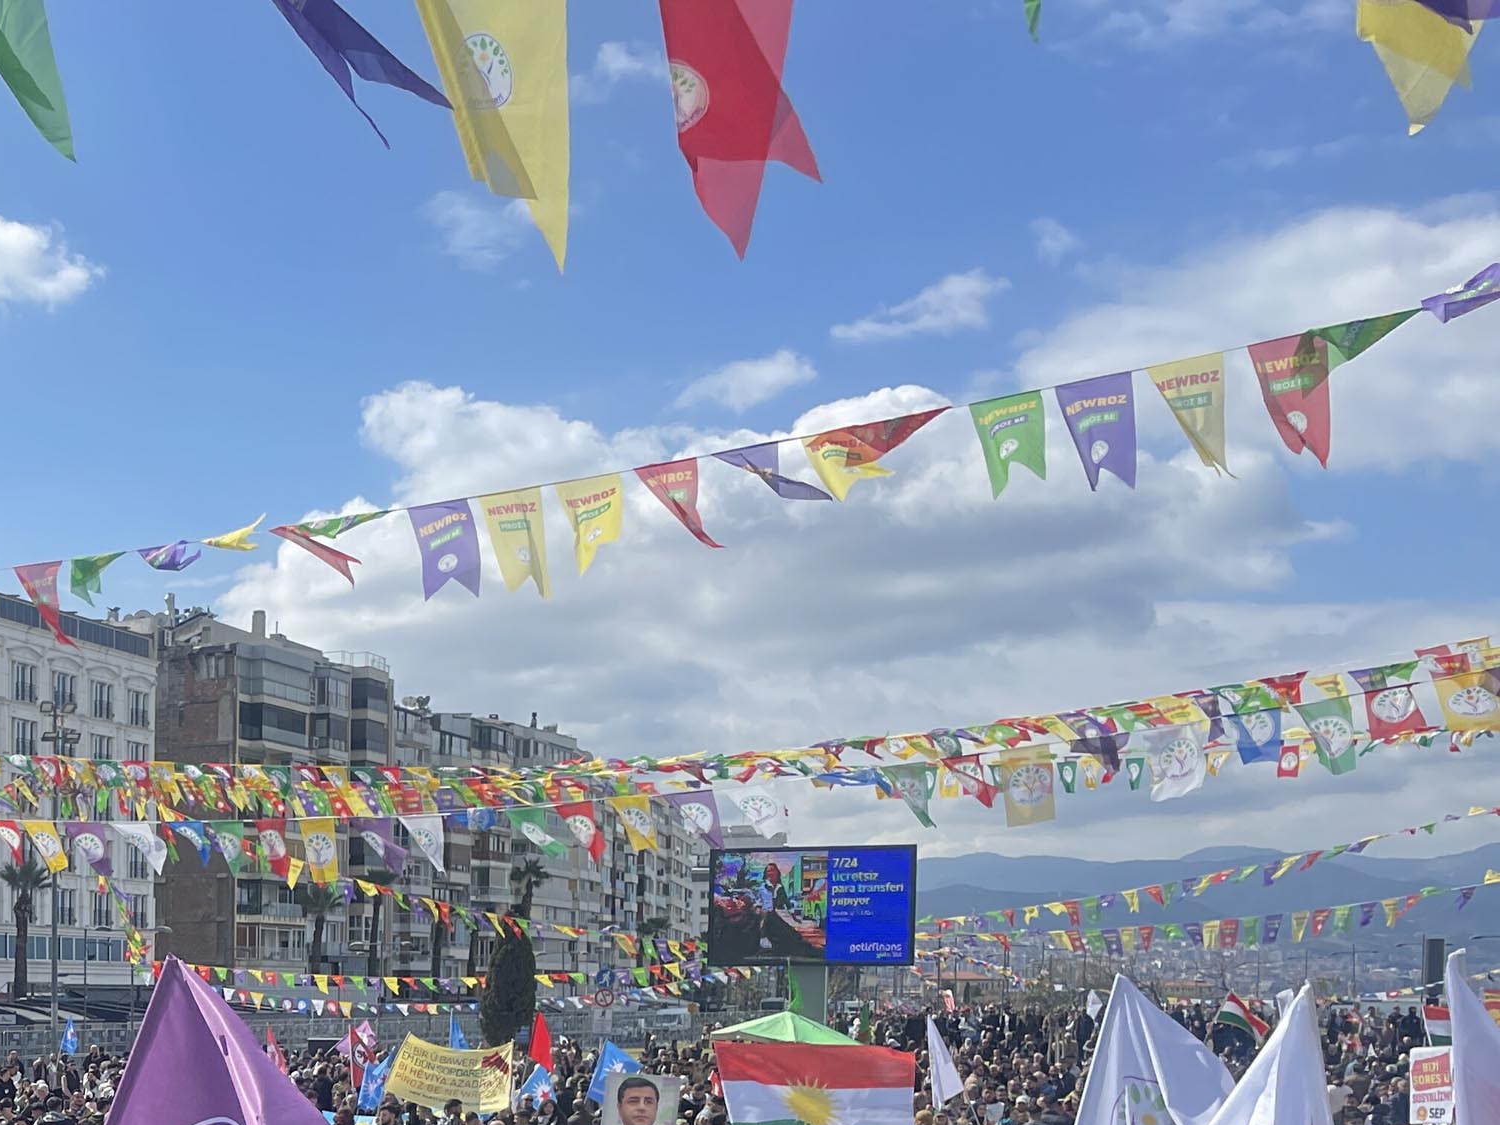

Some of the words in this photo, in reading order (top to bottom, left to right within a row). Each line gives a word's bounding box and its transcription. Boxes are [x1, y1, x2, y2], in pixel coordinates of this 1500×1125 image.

[1155, 370, 1220, 393] NEWROZ
[979, 400, 1038, 426] NEWROZ
[1065, 394, 1128, 417] NEWROZ
[566, 487, 617, 510] NEWROZ
[487, 502, 537, 517] NEWROZ
[419, 512, 468, 538] NEWROZ
[833, 858, 858, 869] 7/24
[832, 885, 856, 896] para
[858, 882, 904, 893] transferi
[850, 942, 902, 953] getirfinans
[1429, 1107, 1445, 1119] SEP
